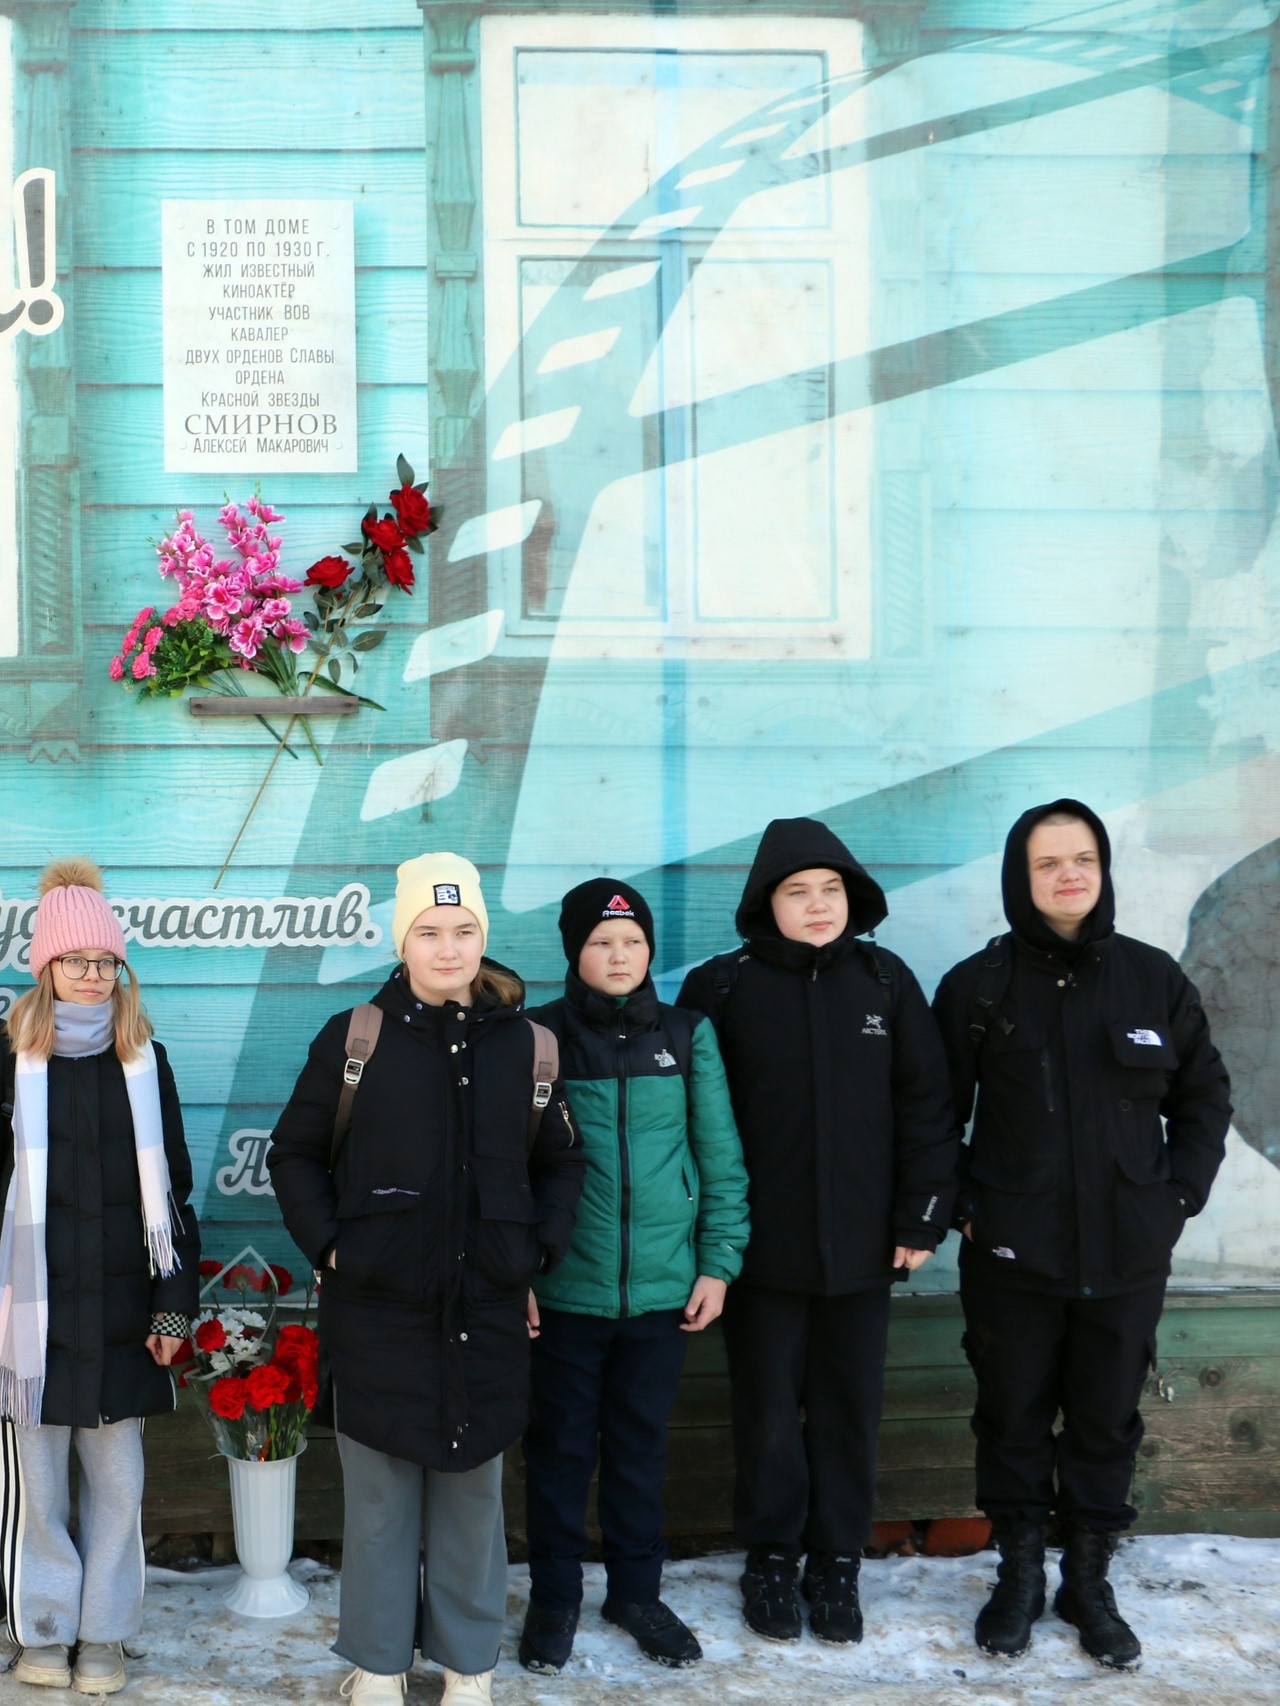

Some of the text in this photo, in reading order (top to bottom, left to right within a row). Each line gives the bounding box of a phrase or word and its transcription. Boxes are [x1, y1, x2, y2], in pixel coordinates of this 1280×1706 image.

[206, 219, 310, 236] В ТОМ ДОМЕ
[187, 242, 195, 257] С
[202, 242, 238, 257] 1920
[247, 242, 266, 257] ПО
[203, 261, 315, 278] ЖИЛ ИЗВЕСТНЫЙ
[223, 282, 295, 299] КИНОАКТЁР
[209, 304, 310, 320] УЧАСТНИК ВОВ
[231, 327, 288, 341] КАВАЛЕР
[185, 350, 219, 365] ДВУХ
[227, 349, 283, 365] ОРДЕНОВ
[235, 370, 285, 386] ОРДЕНА
[268, 393, 320, 408] ЗВЕЗДЫ
[185, 413, 337, 435] СМИРНОВ
[601, 909, 635, 917] Reebok
